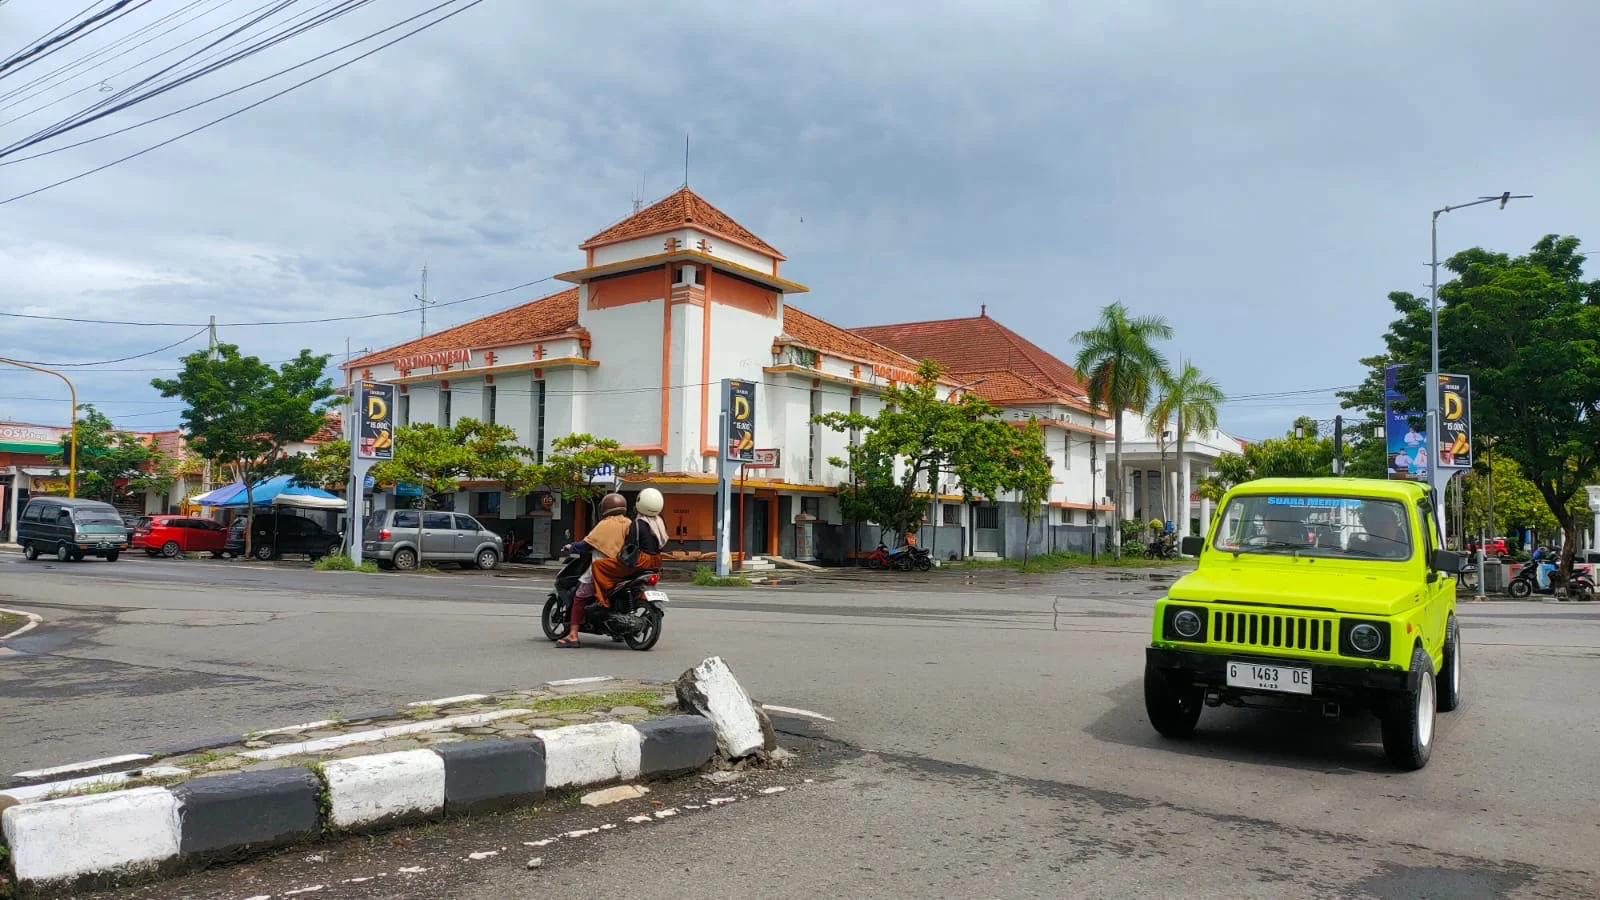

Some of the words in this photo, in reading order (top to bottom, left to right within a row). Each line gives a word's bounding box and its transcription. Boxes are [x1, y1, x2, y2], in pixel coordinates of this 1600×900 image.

[393, 357, 413, 371] POS
[414, 349, 471, 369] INDONESIA
[368, 397, 386, 420] D
[735, 396, 750, 420] D
[1445, 391, 1462, 420] D
[1230, 664, 1237, 678] G
[1252, 667, 1279, 682] 1463
[1293, 670, 1309, 685] DE
